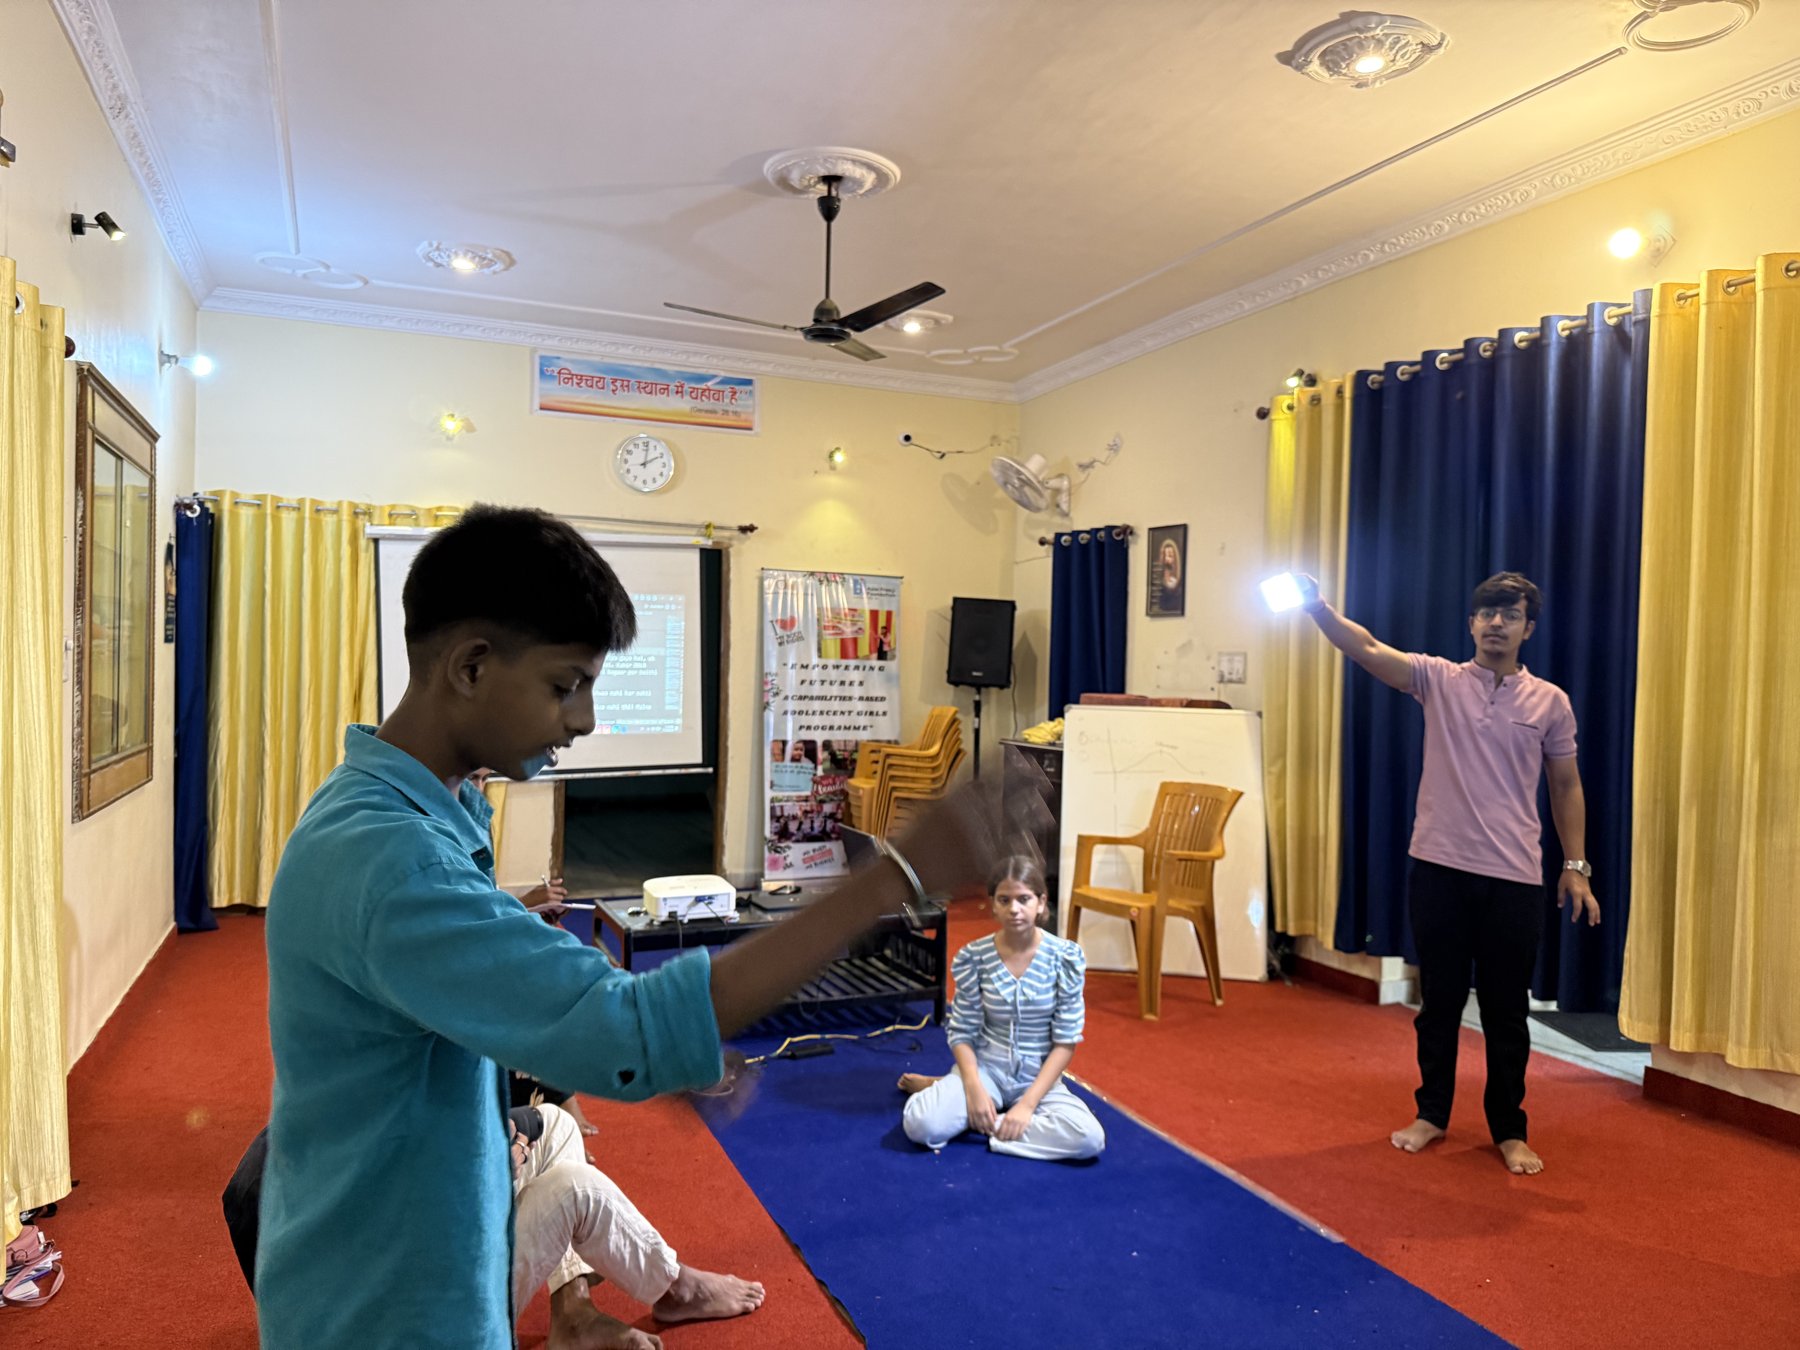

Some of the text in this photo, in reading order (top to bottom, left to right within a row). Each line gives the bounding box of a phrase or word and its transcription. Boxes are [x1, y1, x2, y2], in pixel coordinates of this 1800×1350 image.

[609, 377, 632, 396] इस
[635, 379, 671, 398] स्थान
[674, 381, 686, 400] में
[800, 679, 865, 687] FUTURES
